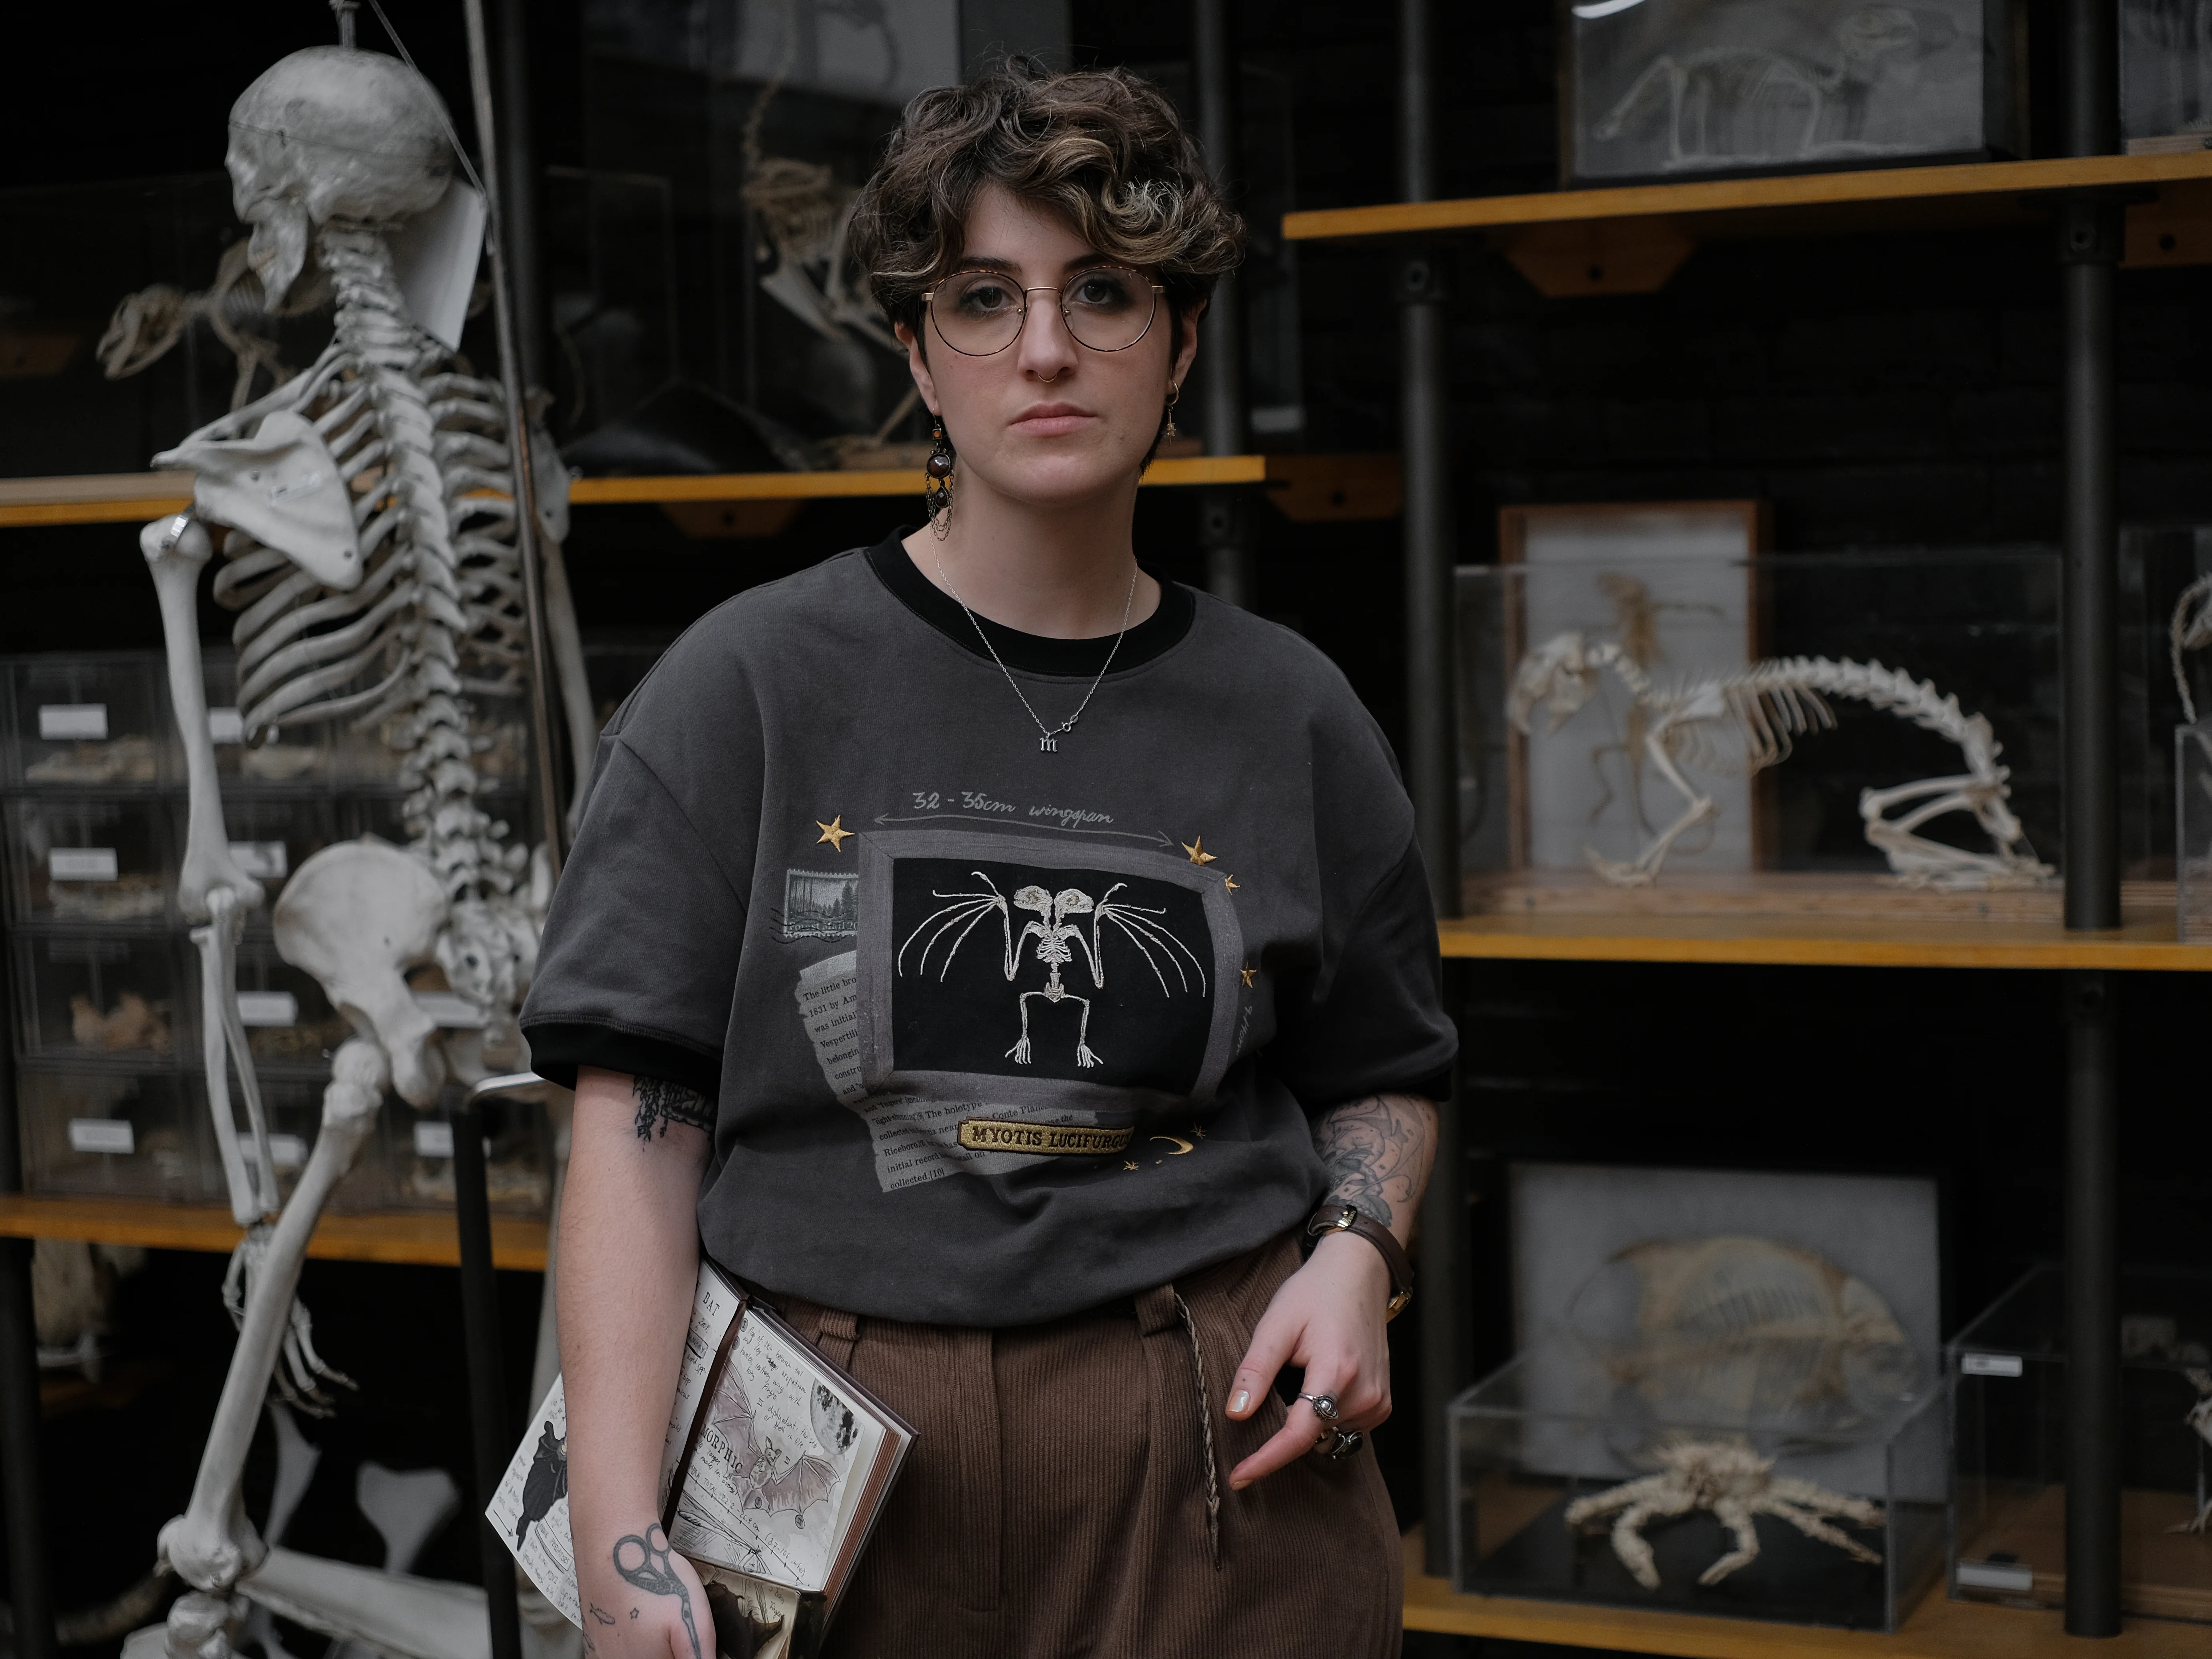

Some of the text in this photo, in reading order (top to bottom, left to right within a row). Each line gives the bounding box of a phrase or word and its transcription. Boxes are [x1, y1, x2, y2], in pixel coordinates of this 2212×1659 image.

[912, 792, 940, 810] 32
[961, 791, 1016, 812] 35cm
[1029, 804, 1114, 828] wingspan
[803, 991, 819, 1001] The
[821, 983, 841, 995] little
[809, 1004, 828, 1017] 1831
[829, 1001, 839, 1011] by
[814, 1023, 830, 1033] was
[820, 1029, 859, 1049] Vespertili
[826, 1048, 860, 1065] belongin
[842, 1084, 857, 1095] and
[925, 1110, 942, 1119] The
[972, 1125, 1043, 1147] MYOTIS
[887, 1159, 913, 1173] initial
[702, 1291, 720, 1317] BAT
